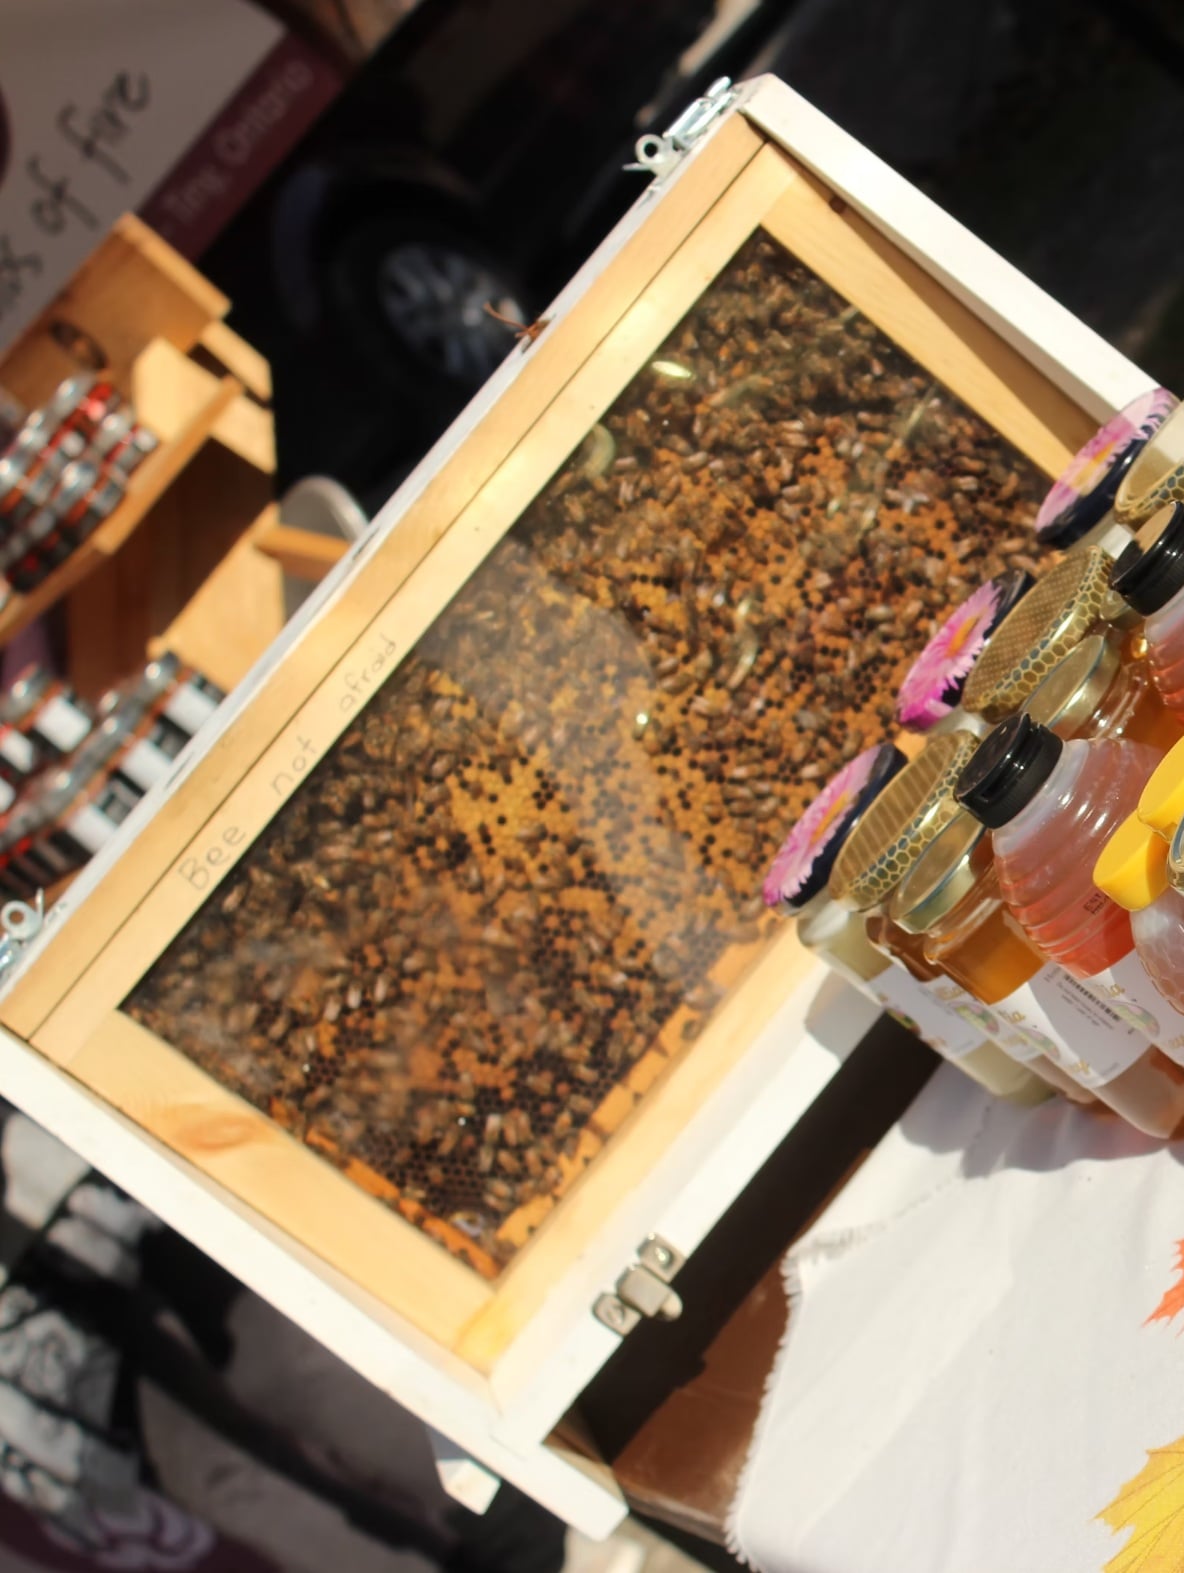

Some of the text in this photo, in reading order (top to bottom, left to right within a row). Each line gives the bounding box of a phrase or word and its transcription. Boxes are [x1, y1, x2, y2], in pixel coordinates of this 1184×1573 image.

[178, 633, 397, 891] Bee not afraid
